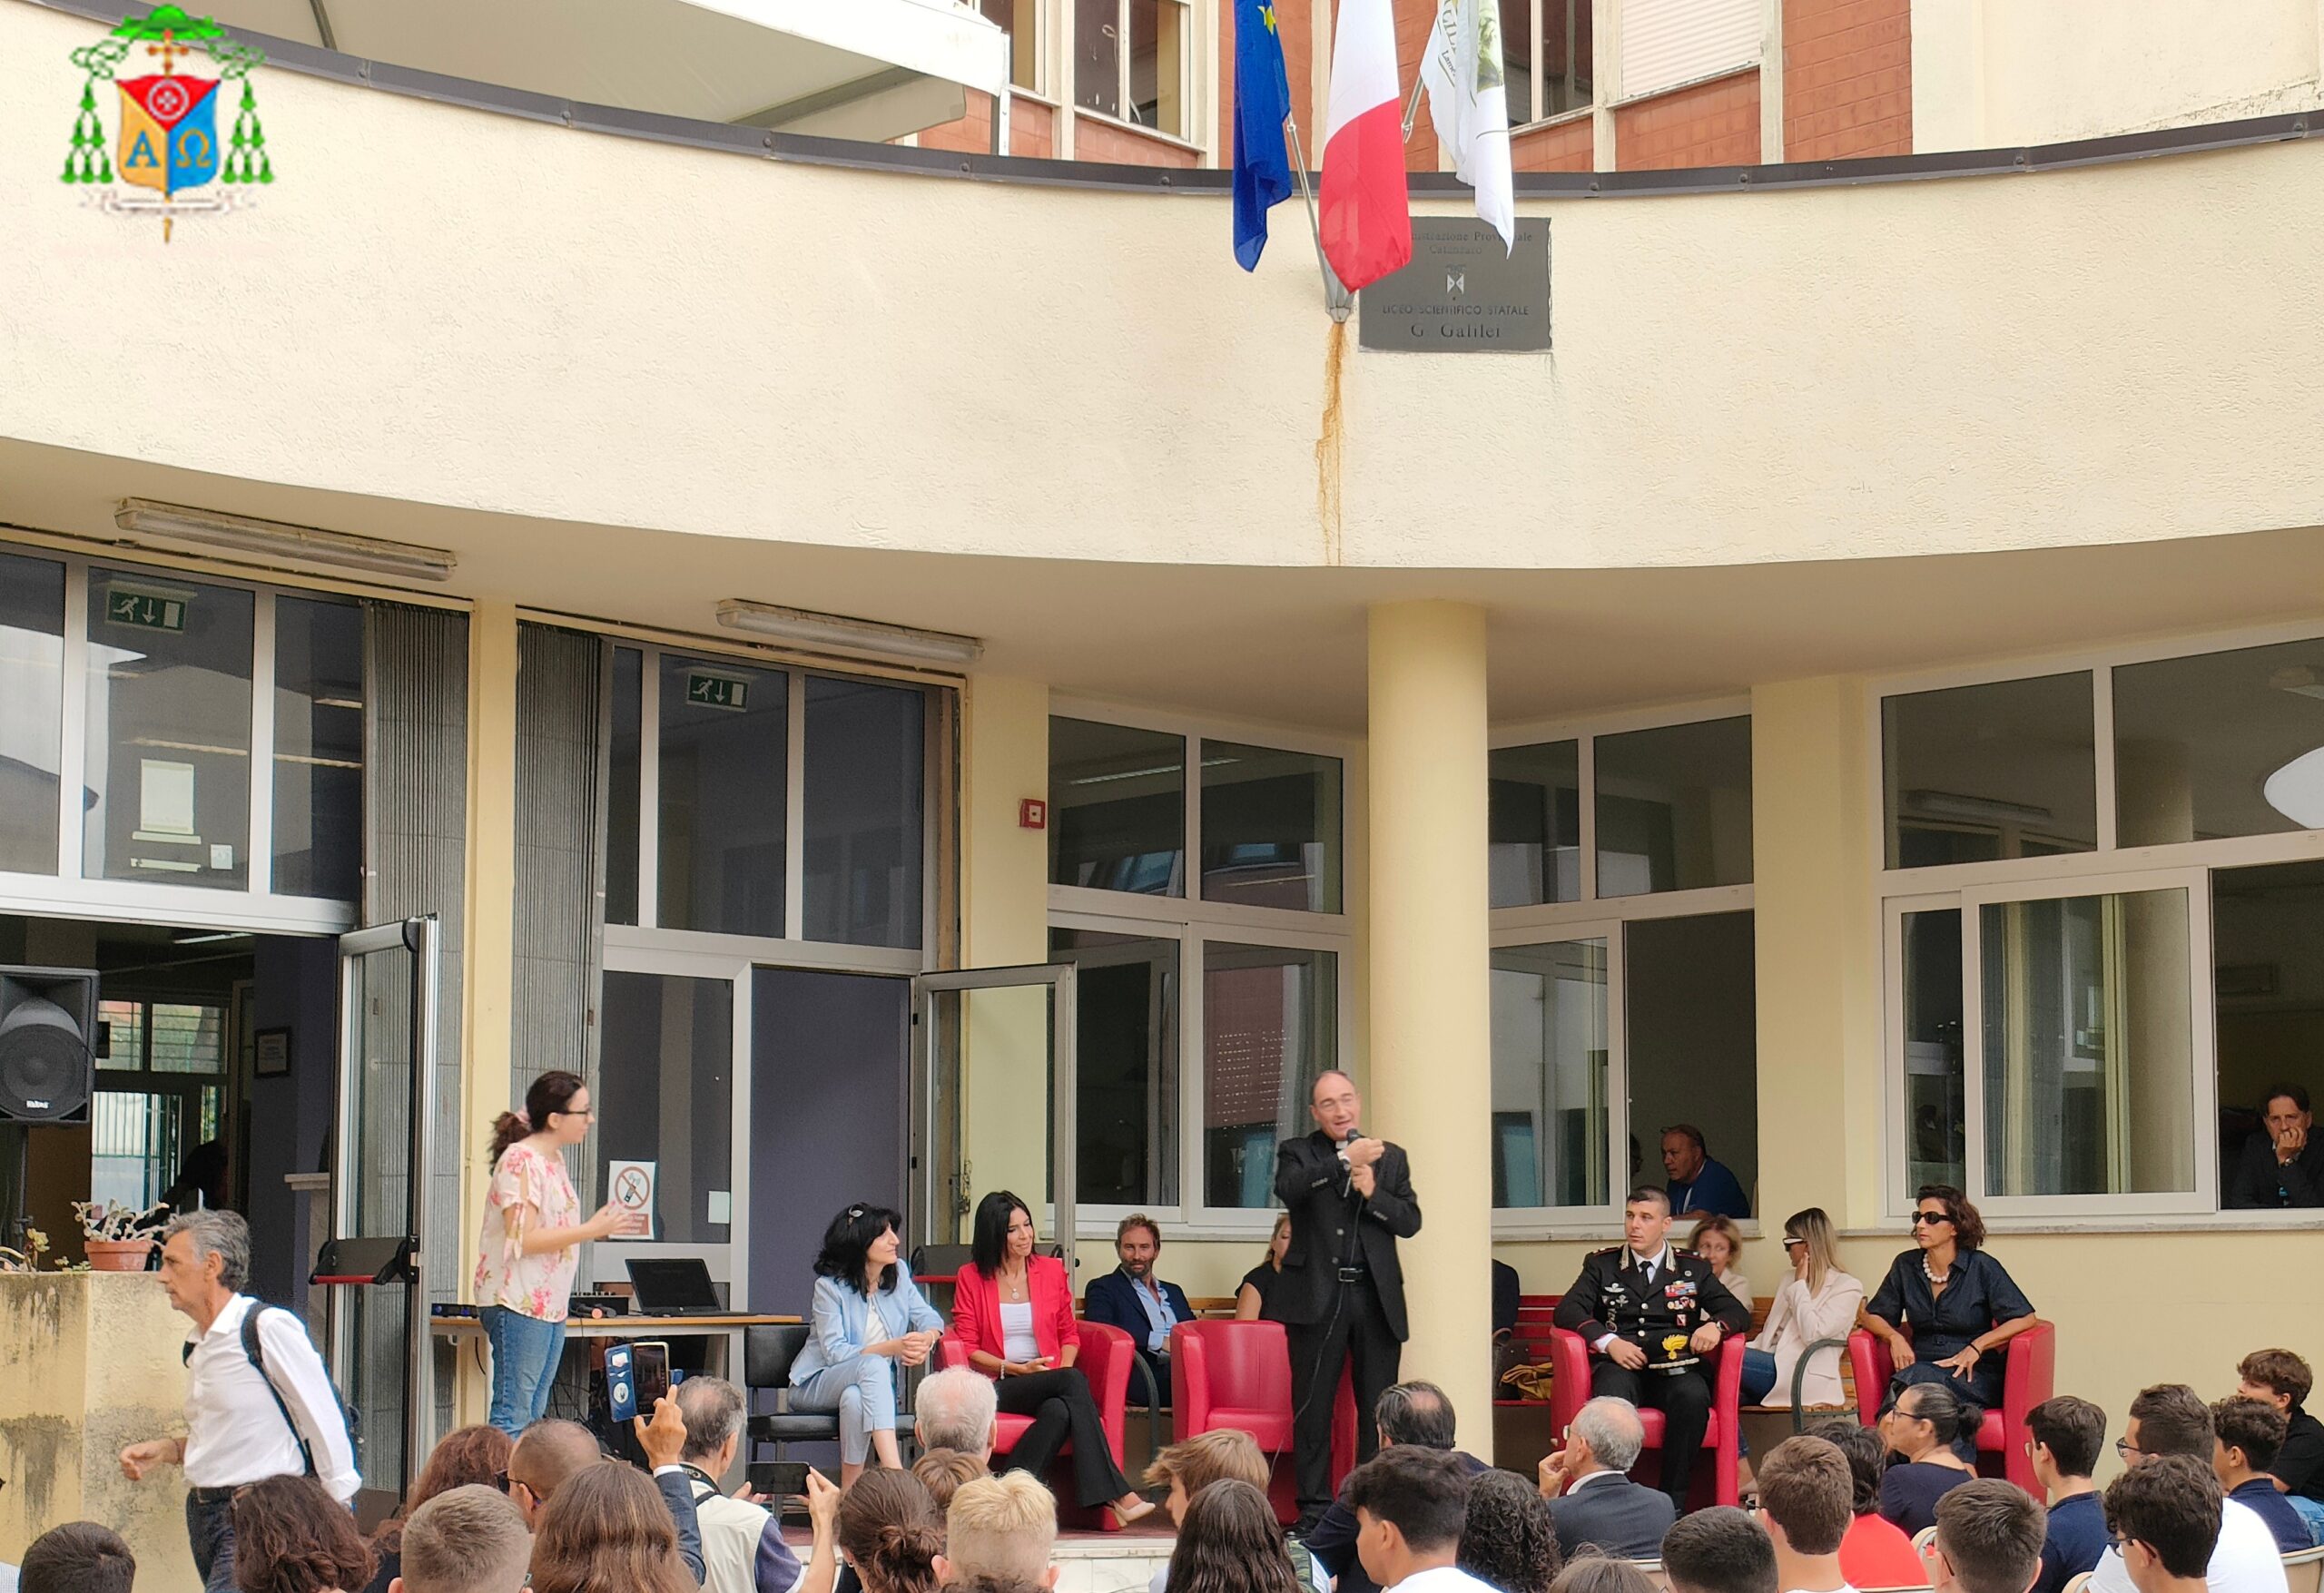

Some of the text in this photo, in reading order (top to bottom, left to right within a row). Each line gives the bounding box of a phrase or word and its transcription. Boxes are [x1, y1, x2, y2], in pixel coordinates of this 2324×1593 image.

[1382, 304, 1529, 316] LICEO SCIENTIFICO STATALE
[1440, 322, 1500, 338] Galilei
